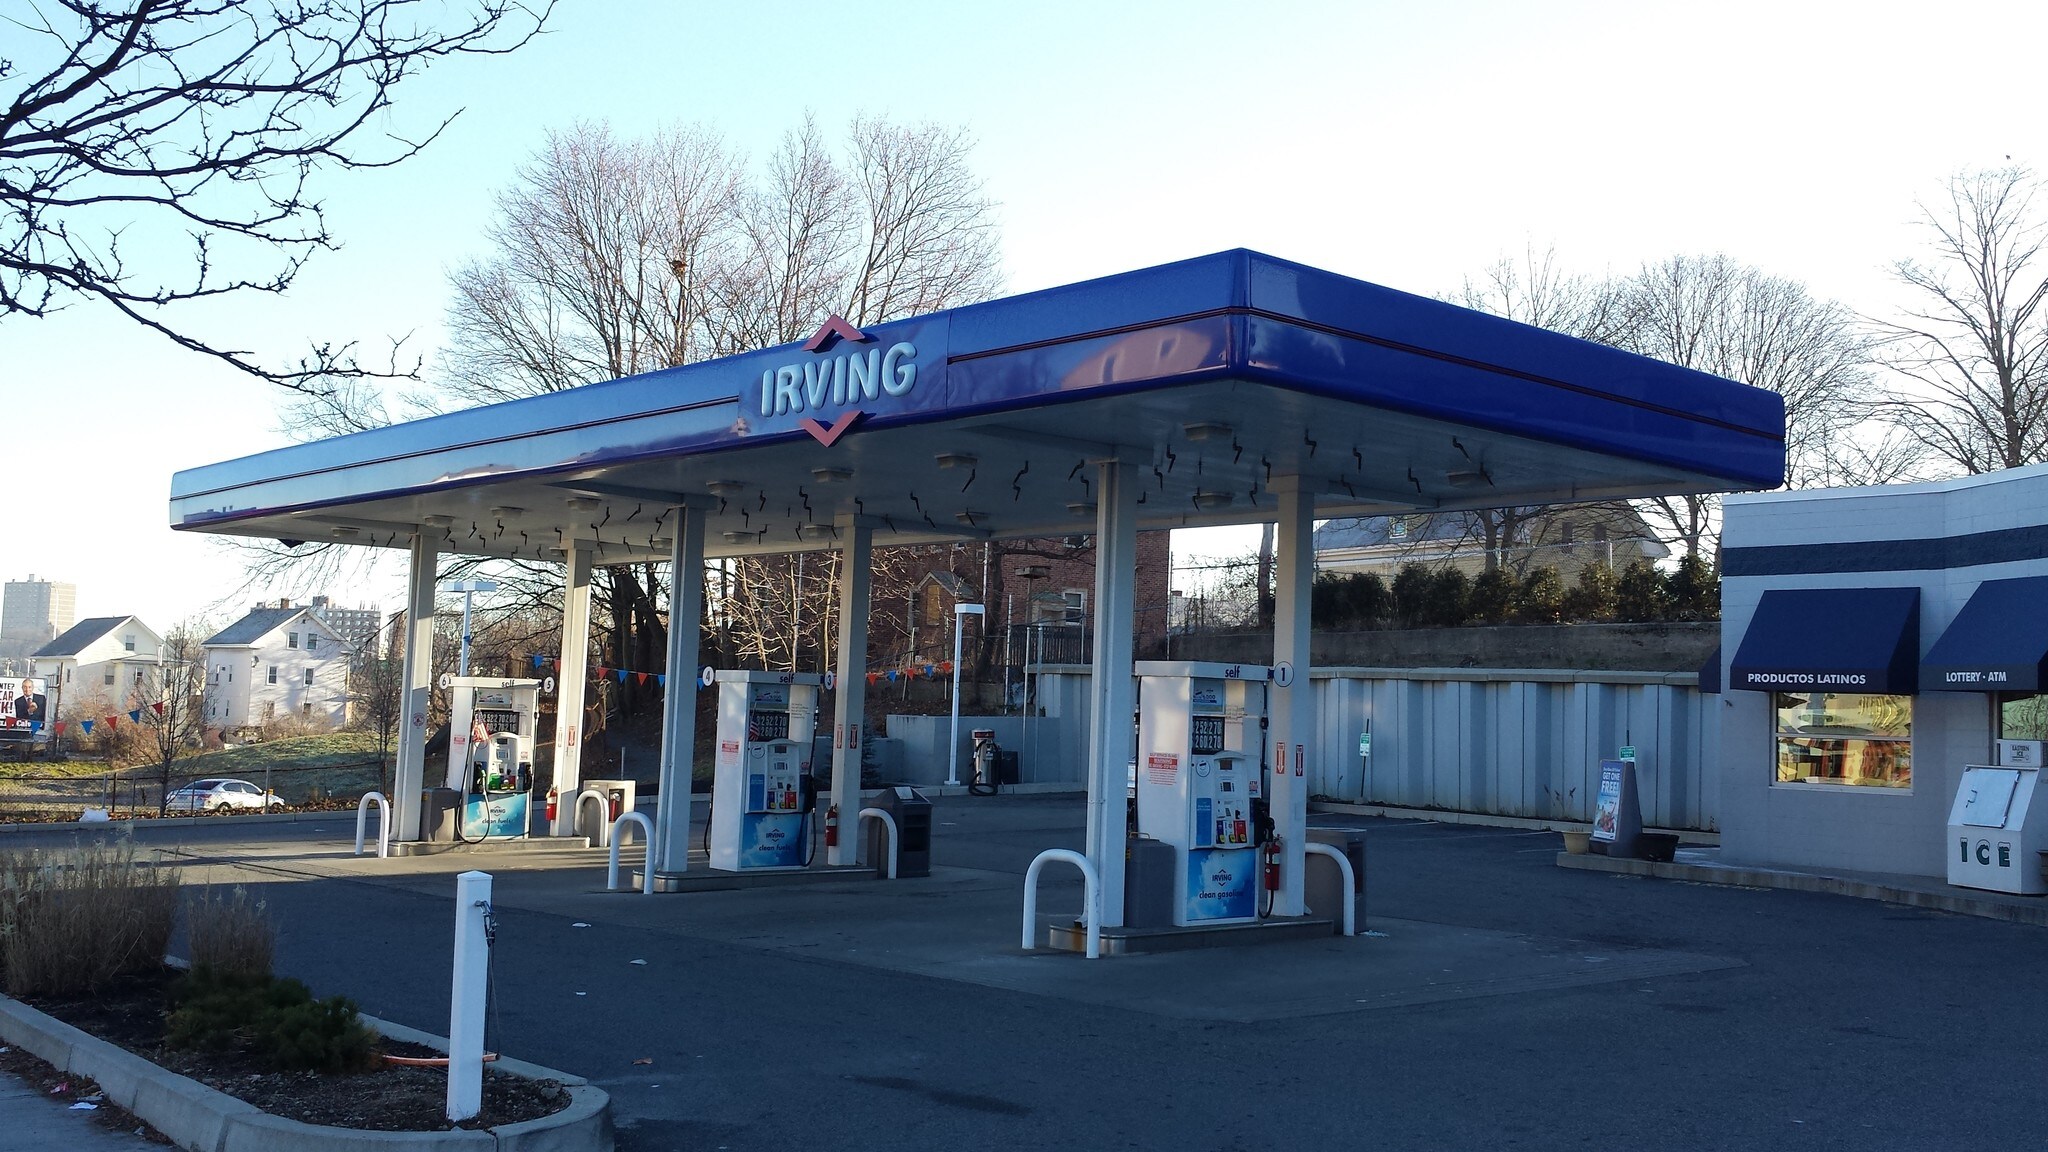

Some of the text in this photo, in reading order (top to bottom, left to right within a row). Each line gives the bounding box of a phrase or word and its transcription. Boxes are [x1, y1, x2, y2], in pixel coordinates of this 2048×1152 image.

[761, 341, 917, 417] IRVING
[705, 671, 711, 682] 4
[1225, 665, 1240, 679] self
[1281, 667, 1286, 682] 1
[1946, 671, 2007, 682] LOTTERY ATM
[441, 677, 446, 686] 6
[501, 679, 515, 688] self
[779, 673, 795, 684] self
[826, 674, 832, 686] 3
[1747, 673, 1866, 685] PRODUCTOS LATINOS
[546, 680, 552, 689] 5
[1610, 772, 1620, 780] ONE
[1960, 837, 2011, 867] ICE
[1212, 874, 1232, 882] IRVING
[1199, 891, 1216, 899] clean
